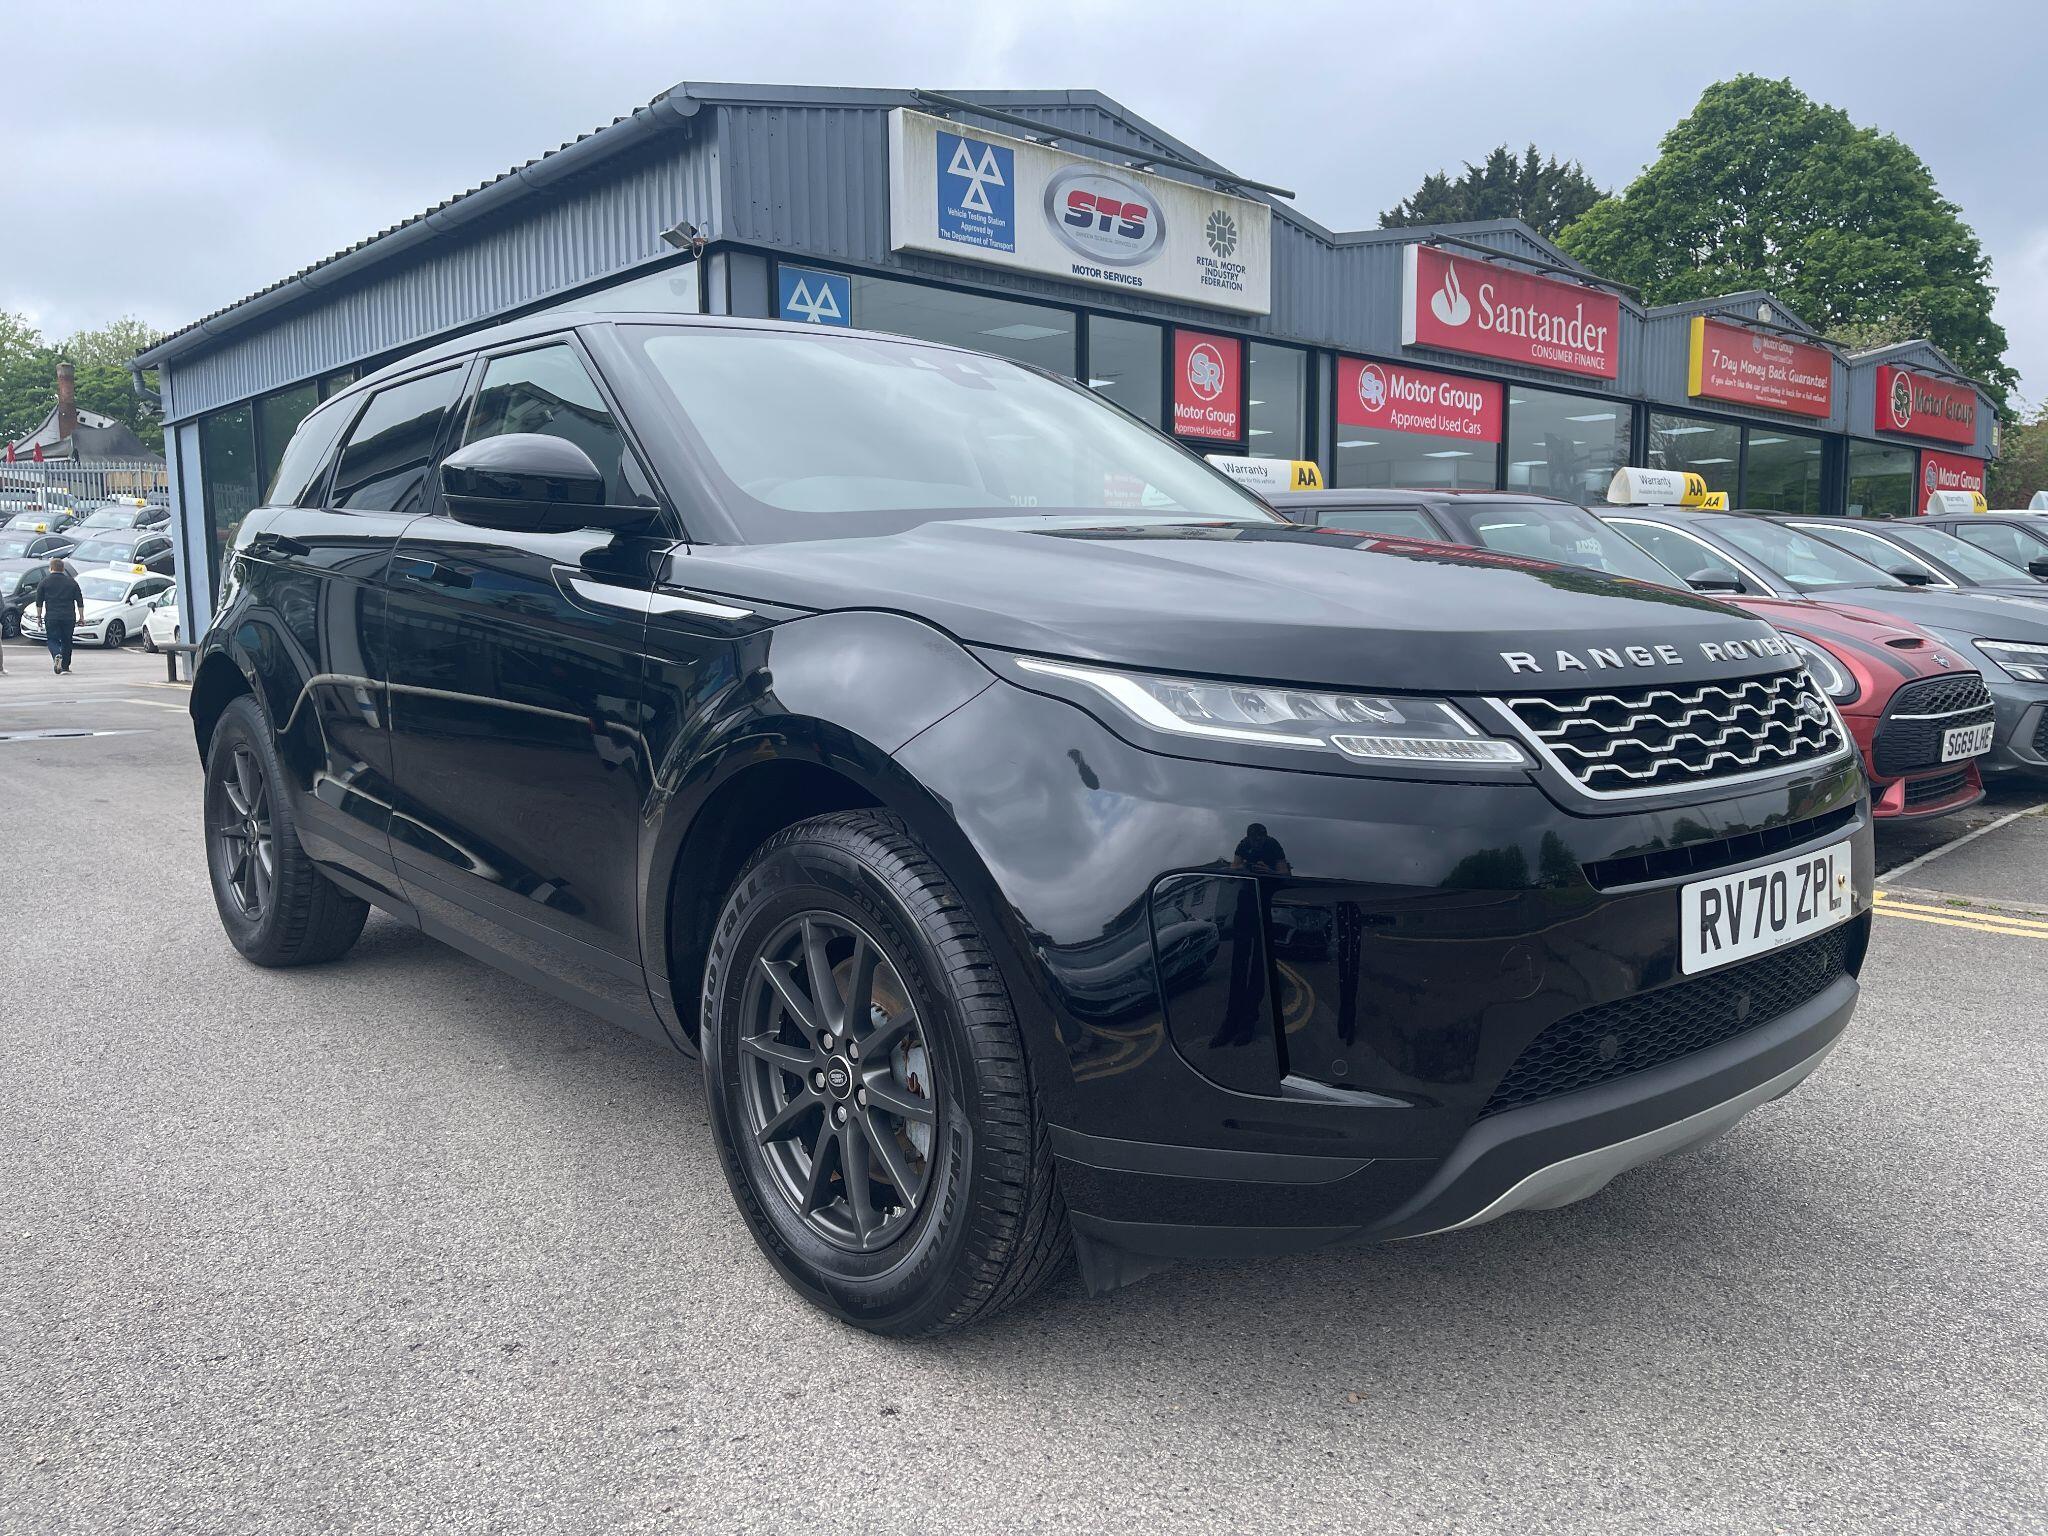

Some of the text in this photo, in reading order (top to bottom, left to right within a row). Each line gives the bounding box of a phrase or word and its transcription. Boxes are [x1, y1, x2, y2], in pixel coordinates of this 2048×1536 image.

[947, 206, 1006, 227] Vehicle Testing Station
[1064, 190, 1148, 239] STS
[940, 228, 1014, 251] The Department of Transport
[961, 221, 994, 238] Approved by
[1072, 263, 1143, 287] MOTOR SERVICES
[1196, 256, 1246, 274] RETAIL MOTOR
[1205, 267, 1239, 281] INDUSTRY
[1200, 275, 1243, 292] FEDERATION
[1478, 283, 1607, 353] Santander
[1531, 344, 1605, 370] CONSUMER FINANCE
[1711, 349, 1828, 389] 7 Day Money Back Guarantee!
[1191, 352, 1222, 393] SR
[1361, 371, 1386, 406] SR
[1390, 374, 1483, 415] Motor Group
[1174, 402, 1236, 426] Motor Group
[1913, 386, 1974, 428] Motor Group
[1174, 422, 1236, 437] Approved Used Cars
[1390, 409, 1481, 435] Approved Used Cars
[1223, 462, 1268, 477] Warranty
[1297, 467, 1317, 486] AA
[1639, 475, 1671, 488] Warranty
[1938, 467, 1981, 491] Motor Group
[1689, 478, 1702, 496] AA
[1704, 496, 1720, 507] AA
[1974, 495, 1984, 507] AA
[1500, 637, 1793, 674] RANGE ROVER
[1947, 730, 1974, 756] SG69
[1700, 854, 1841, 955] RV70 ZPL
